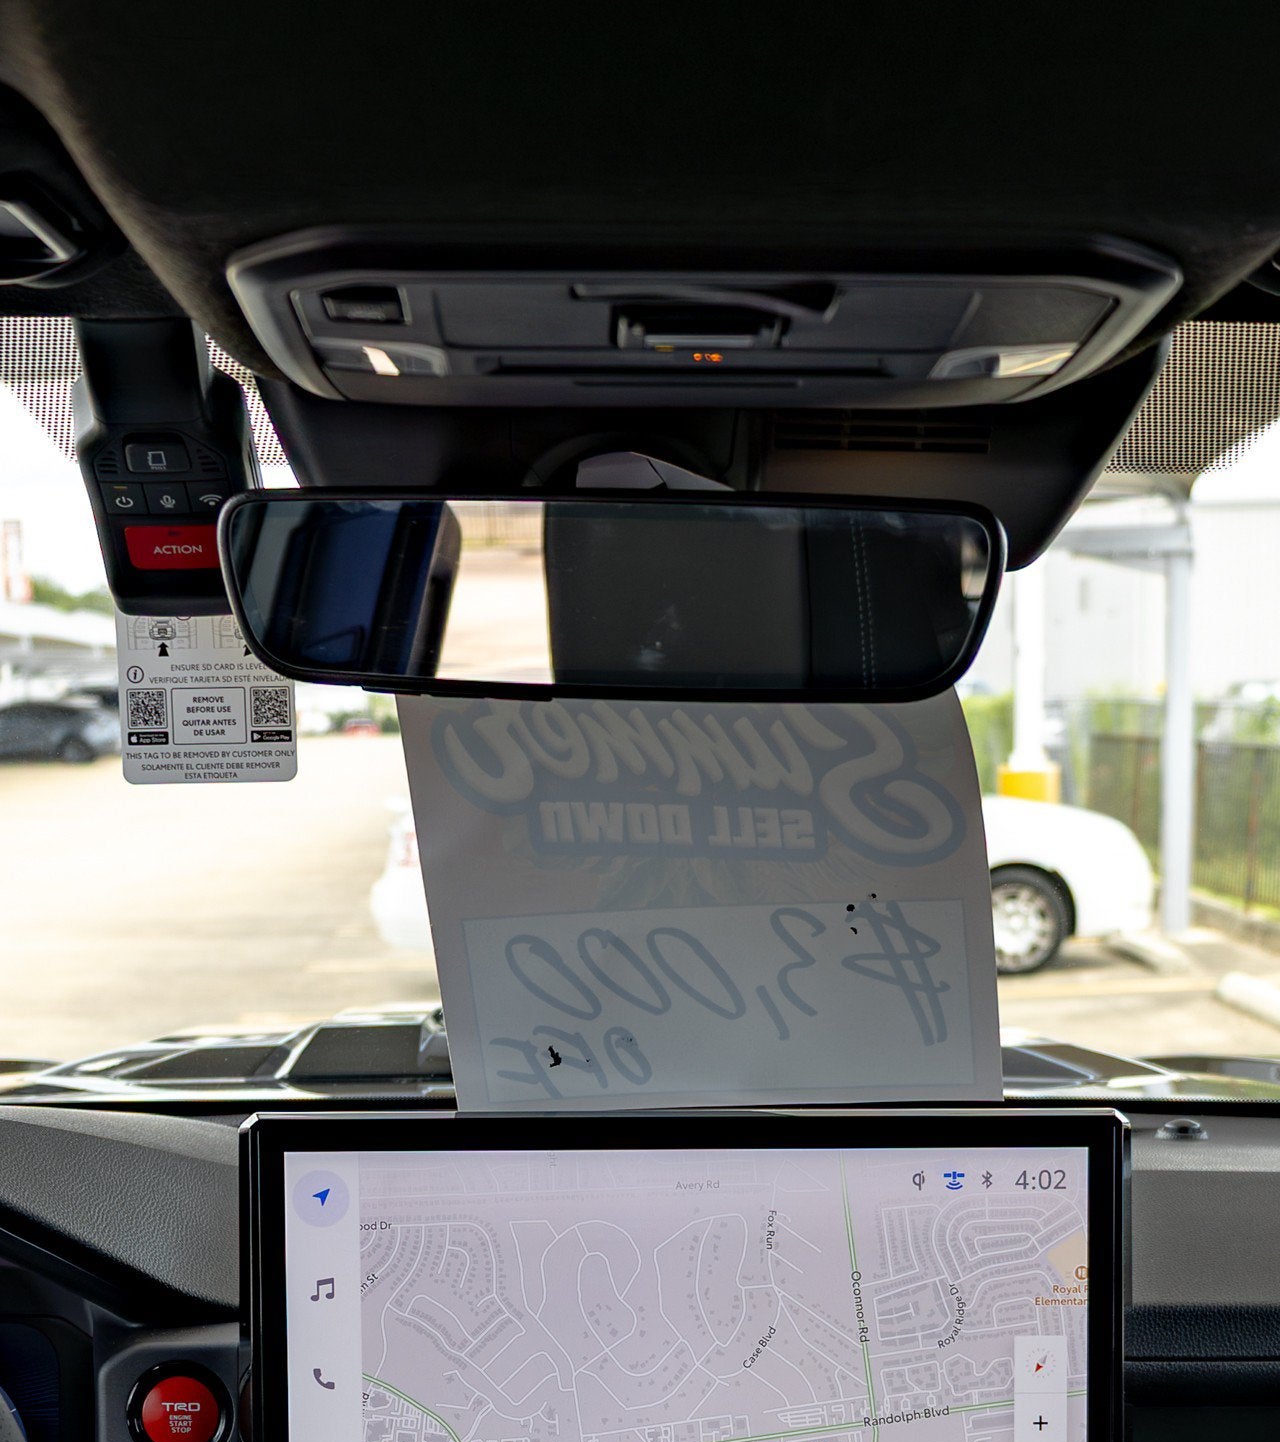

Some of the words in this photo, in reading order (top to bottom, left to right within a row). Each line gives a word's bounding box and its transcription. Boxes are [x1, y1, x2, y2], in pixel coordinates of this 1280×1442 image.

[153, 545, 202, 555] ACTION
[193, 696, 224, 704] REMOVE
[183, 751, 220, 759] REMOVED
[675, 1179, 701, 1190] Avery
[703, 1179, 720, 1189] Rd
[1015, 1169, 1067, 1191] 4:02
[767, 1210, 777, 1226] Fox
[766, 1228, 775, 1250] Run
[949, 1283, 959, 1296] Dr
[851, 1271, 866, 1326] Oconnor
[860, 1328, 869, 1343] Rd
[955, 1296, 967, 1325] Ridge
[937, 1326, 961, 1348] Royal
[743, 1350, 762, 1369] Case
[756, 1326, 777, 1353] Blvd
[161, 1402, 200, 1412] TRD
[863, 1411, 920, 1428] Randolph
[923, 1405, 950, 1419] Blvd
